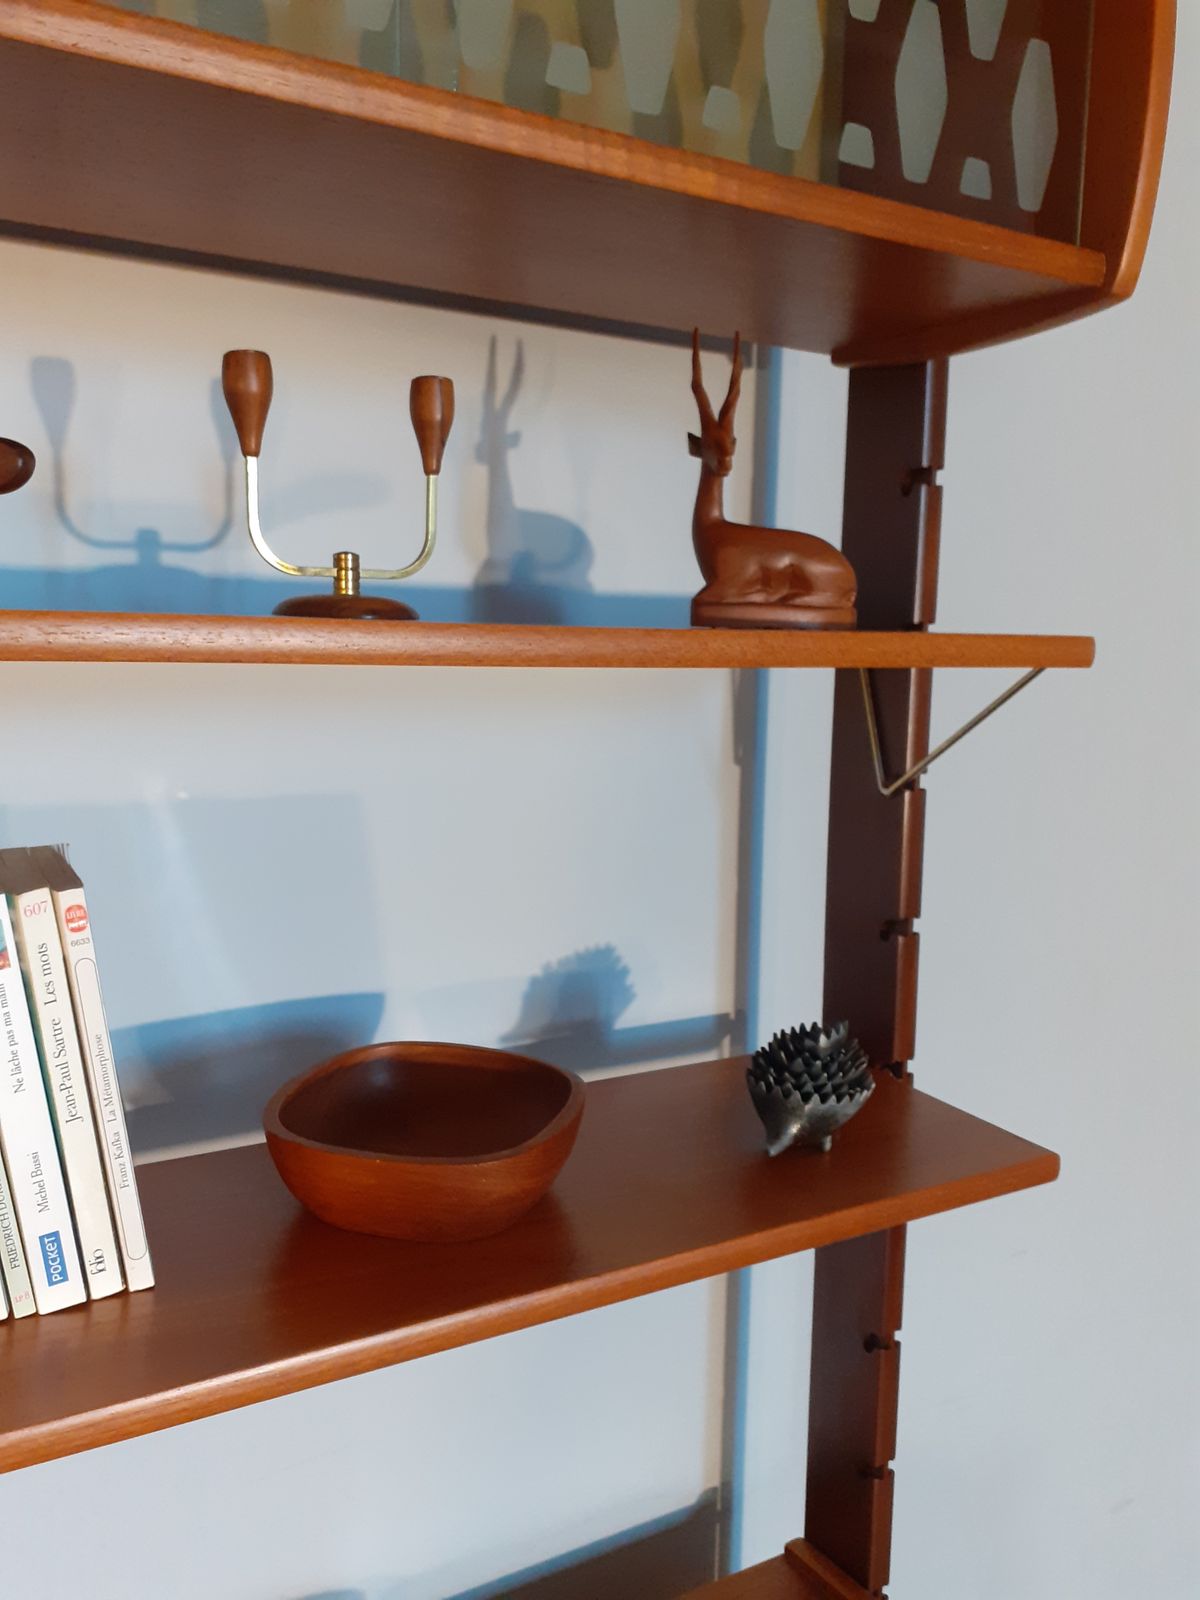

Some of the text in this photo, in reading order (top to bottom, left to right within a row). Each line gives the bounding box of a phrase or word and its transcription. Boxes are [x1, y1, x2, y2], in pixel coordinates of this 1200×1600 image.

[23, 900, 48, 918] 607
[3, 1011, 13, 1027] ma
[38, 942, 84, 1124] Jean-Paul Sartre Les mots
[7, 1029, 19, 1048] pas
[8, 1049, 24, 1077] lâche
[12, 1077, 26, 1094] Ne
[95, 1034, 130, 1189] Franz Kafka La Métamorphose
[27, 1151, 43, 1179] Bussi
[32, 1180, 50, 1213] Michel
[0, 1212, 20, 1270] FRIEDRICH
[88, 1248, 107, 1276] folio
